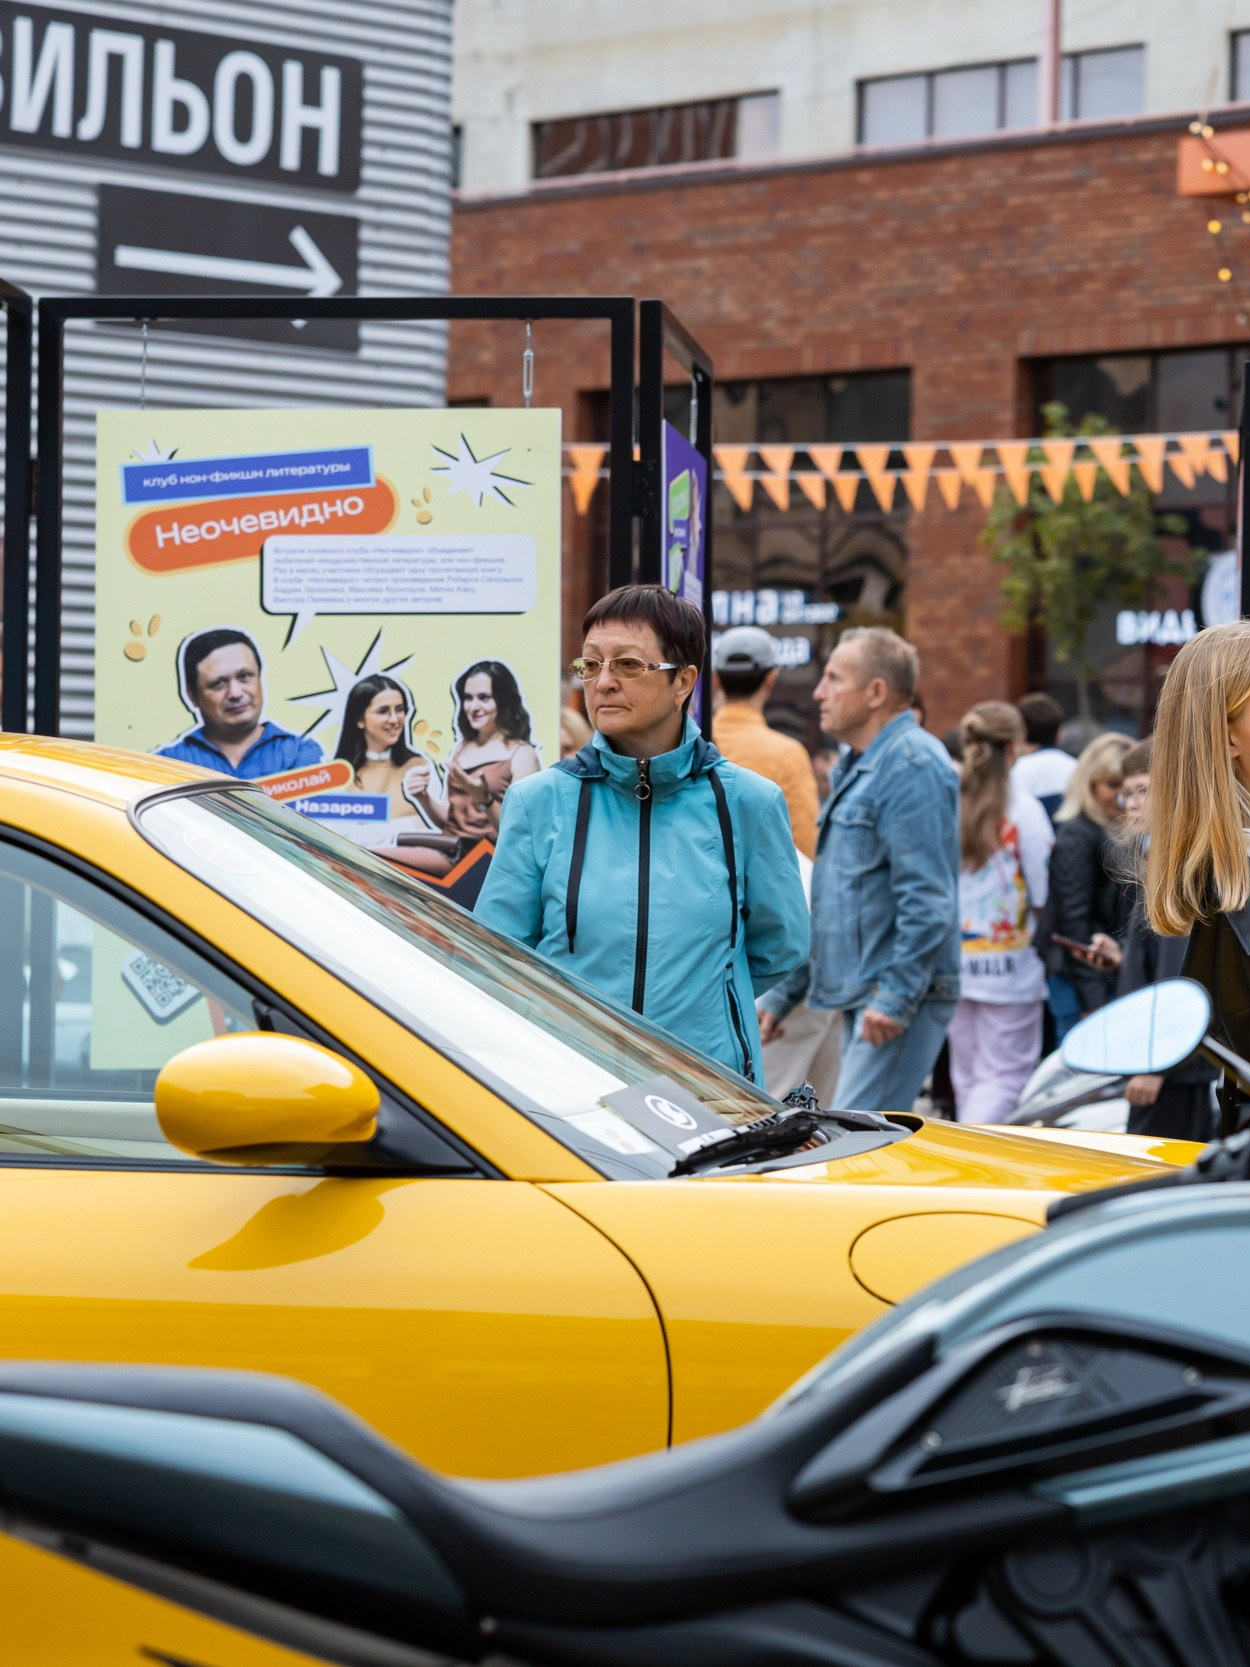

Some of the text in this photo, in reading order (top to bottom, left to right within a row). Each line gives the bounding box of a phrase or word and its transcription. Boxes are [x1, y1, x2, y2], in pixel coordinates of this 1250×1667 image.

[0, 15, 343, 178] ИЛЬОН
[143, 462, 351, 488] клуб нон-фикшн литературы
[155, 496, 365, 549] Неочевидно
[296, 801, 375, 816] Назаров
